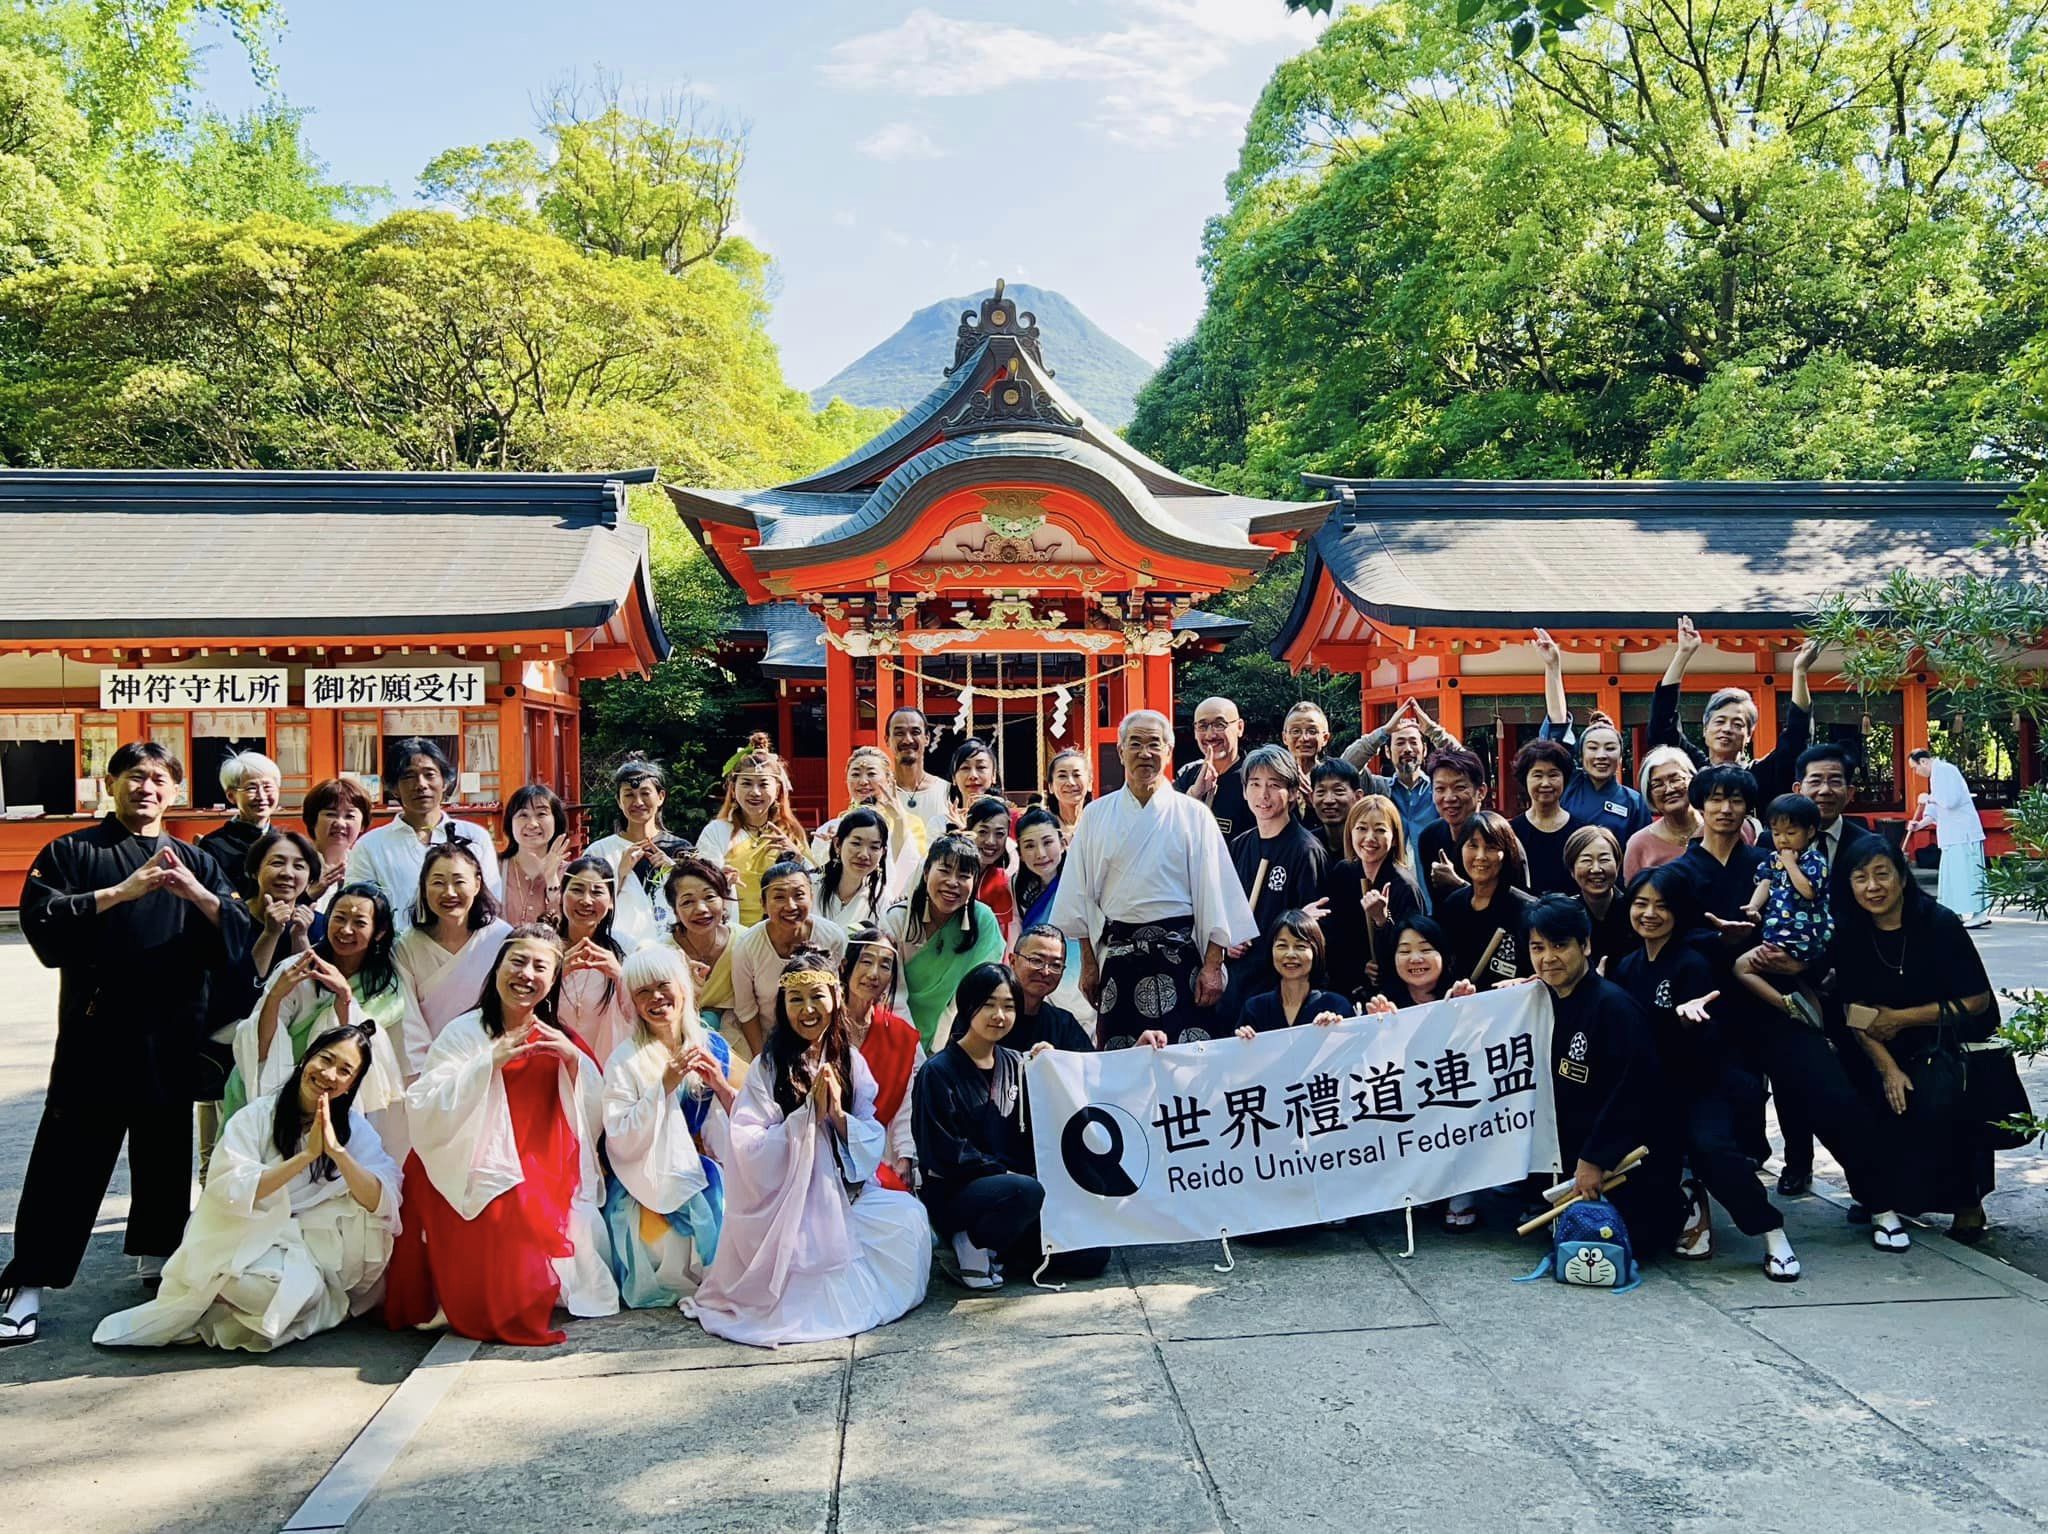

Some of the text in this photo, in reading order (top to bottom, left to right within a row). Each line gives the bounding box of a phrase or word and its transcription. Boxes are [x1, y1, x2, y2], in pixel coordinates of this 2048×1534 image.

[108, 674, 280, 704] 神符守札所
[312, 672, 478, 704] 御祈願受付
[1152, 1032, 1537, 1153] 世界禮道連盟
[1168, 1161, 1244, 1193] Reido
[1255, 1136, 1386, 1181] Universal
